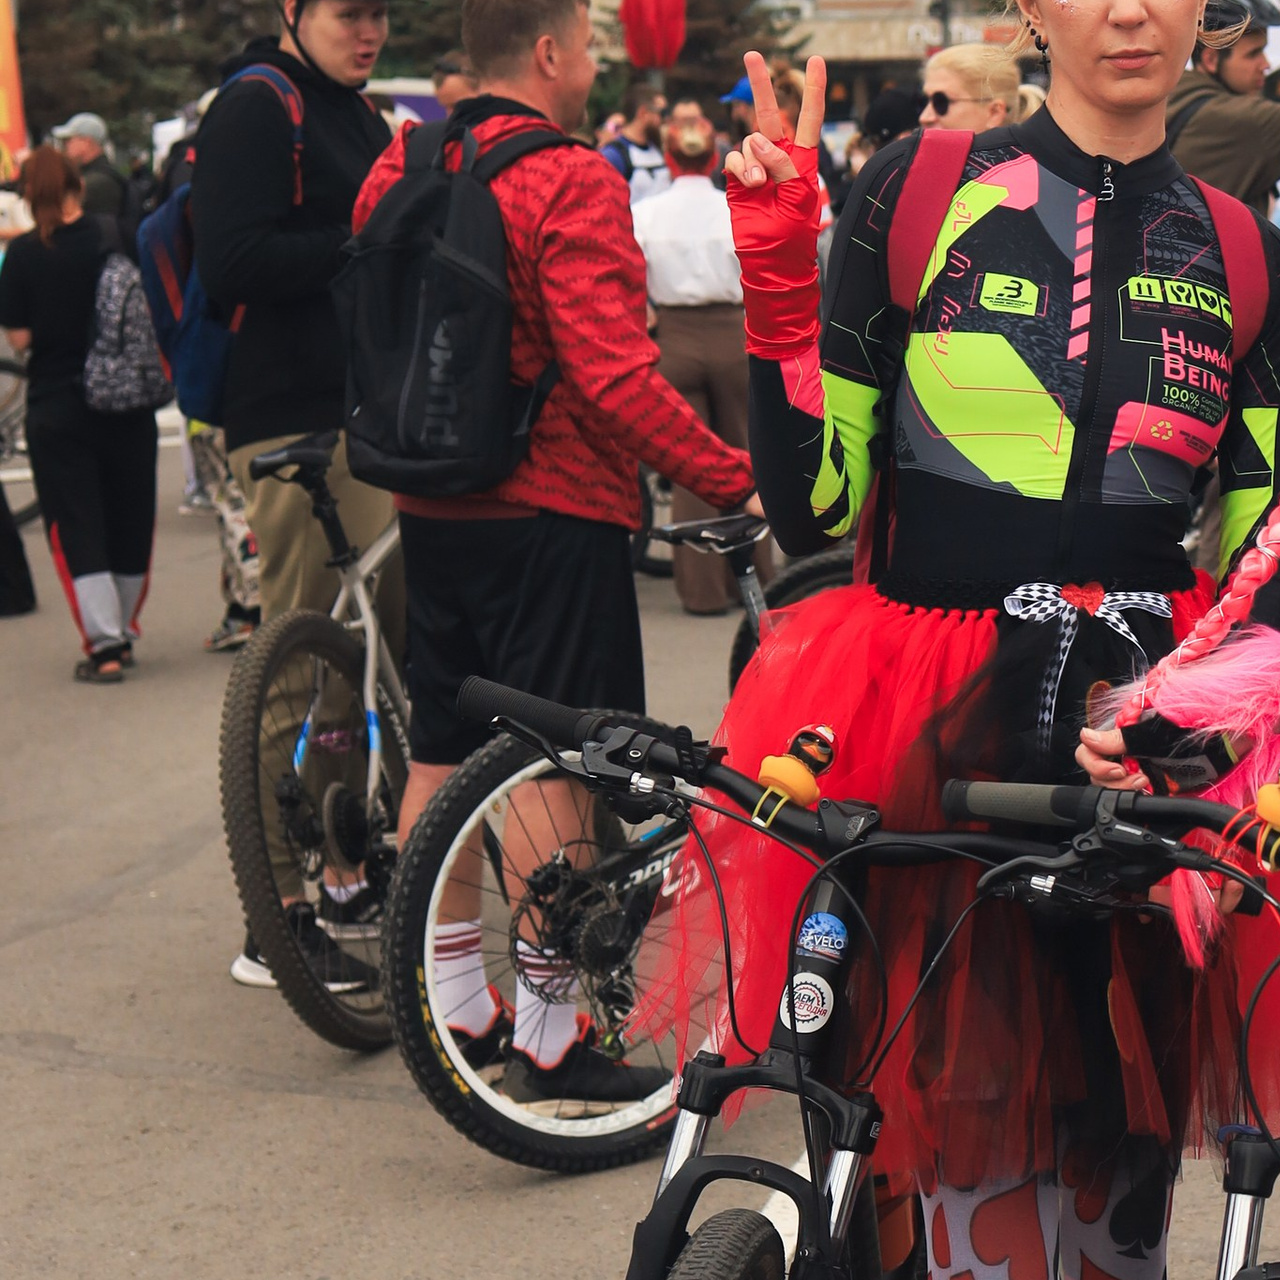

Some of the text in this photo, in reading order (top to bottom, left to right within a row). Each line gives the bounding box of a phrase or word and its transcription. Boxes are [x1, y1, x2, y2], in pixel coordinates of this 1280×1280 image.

[1162, 384, 1200, 407] 100%
[1161, 396, 1198, 414] ORGANIC
[813, 934, 844, 950] VELO
[794, 1001, 828, 1017] СЕГОДНЯ
